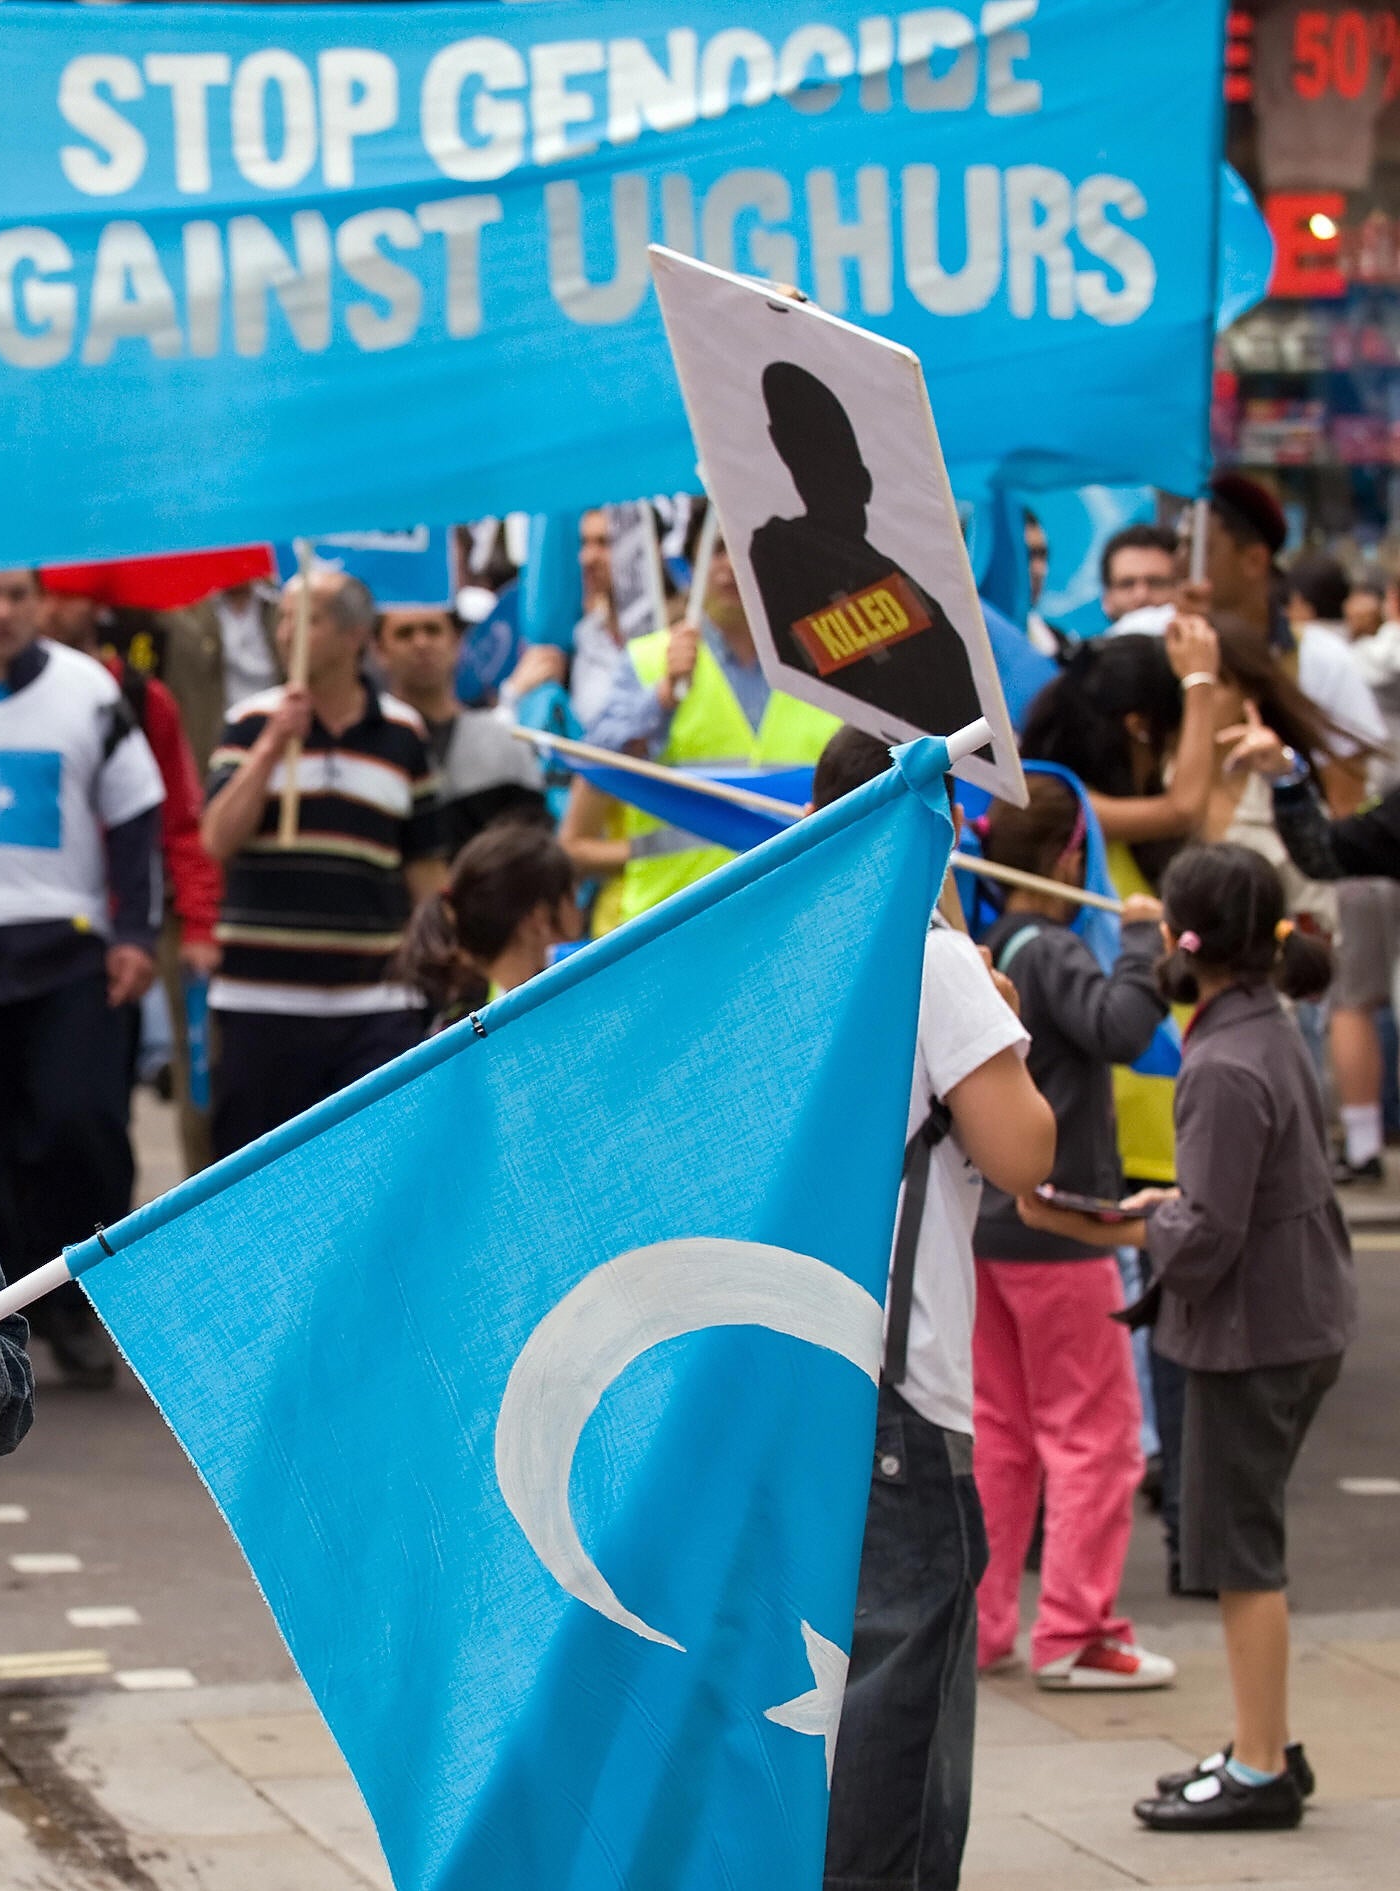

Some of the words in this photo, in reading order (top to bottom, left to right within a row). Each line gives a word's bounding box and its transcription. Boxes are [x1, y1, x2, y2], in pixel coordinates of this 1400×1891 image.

[58, 46, 397, 196] STOP
[420, 0, 1042, 182] GENOCIDE
[544, 163, 1156, 326] UIGHURS
[810, 588, 910, 661] KILLED
